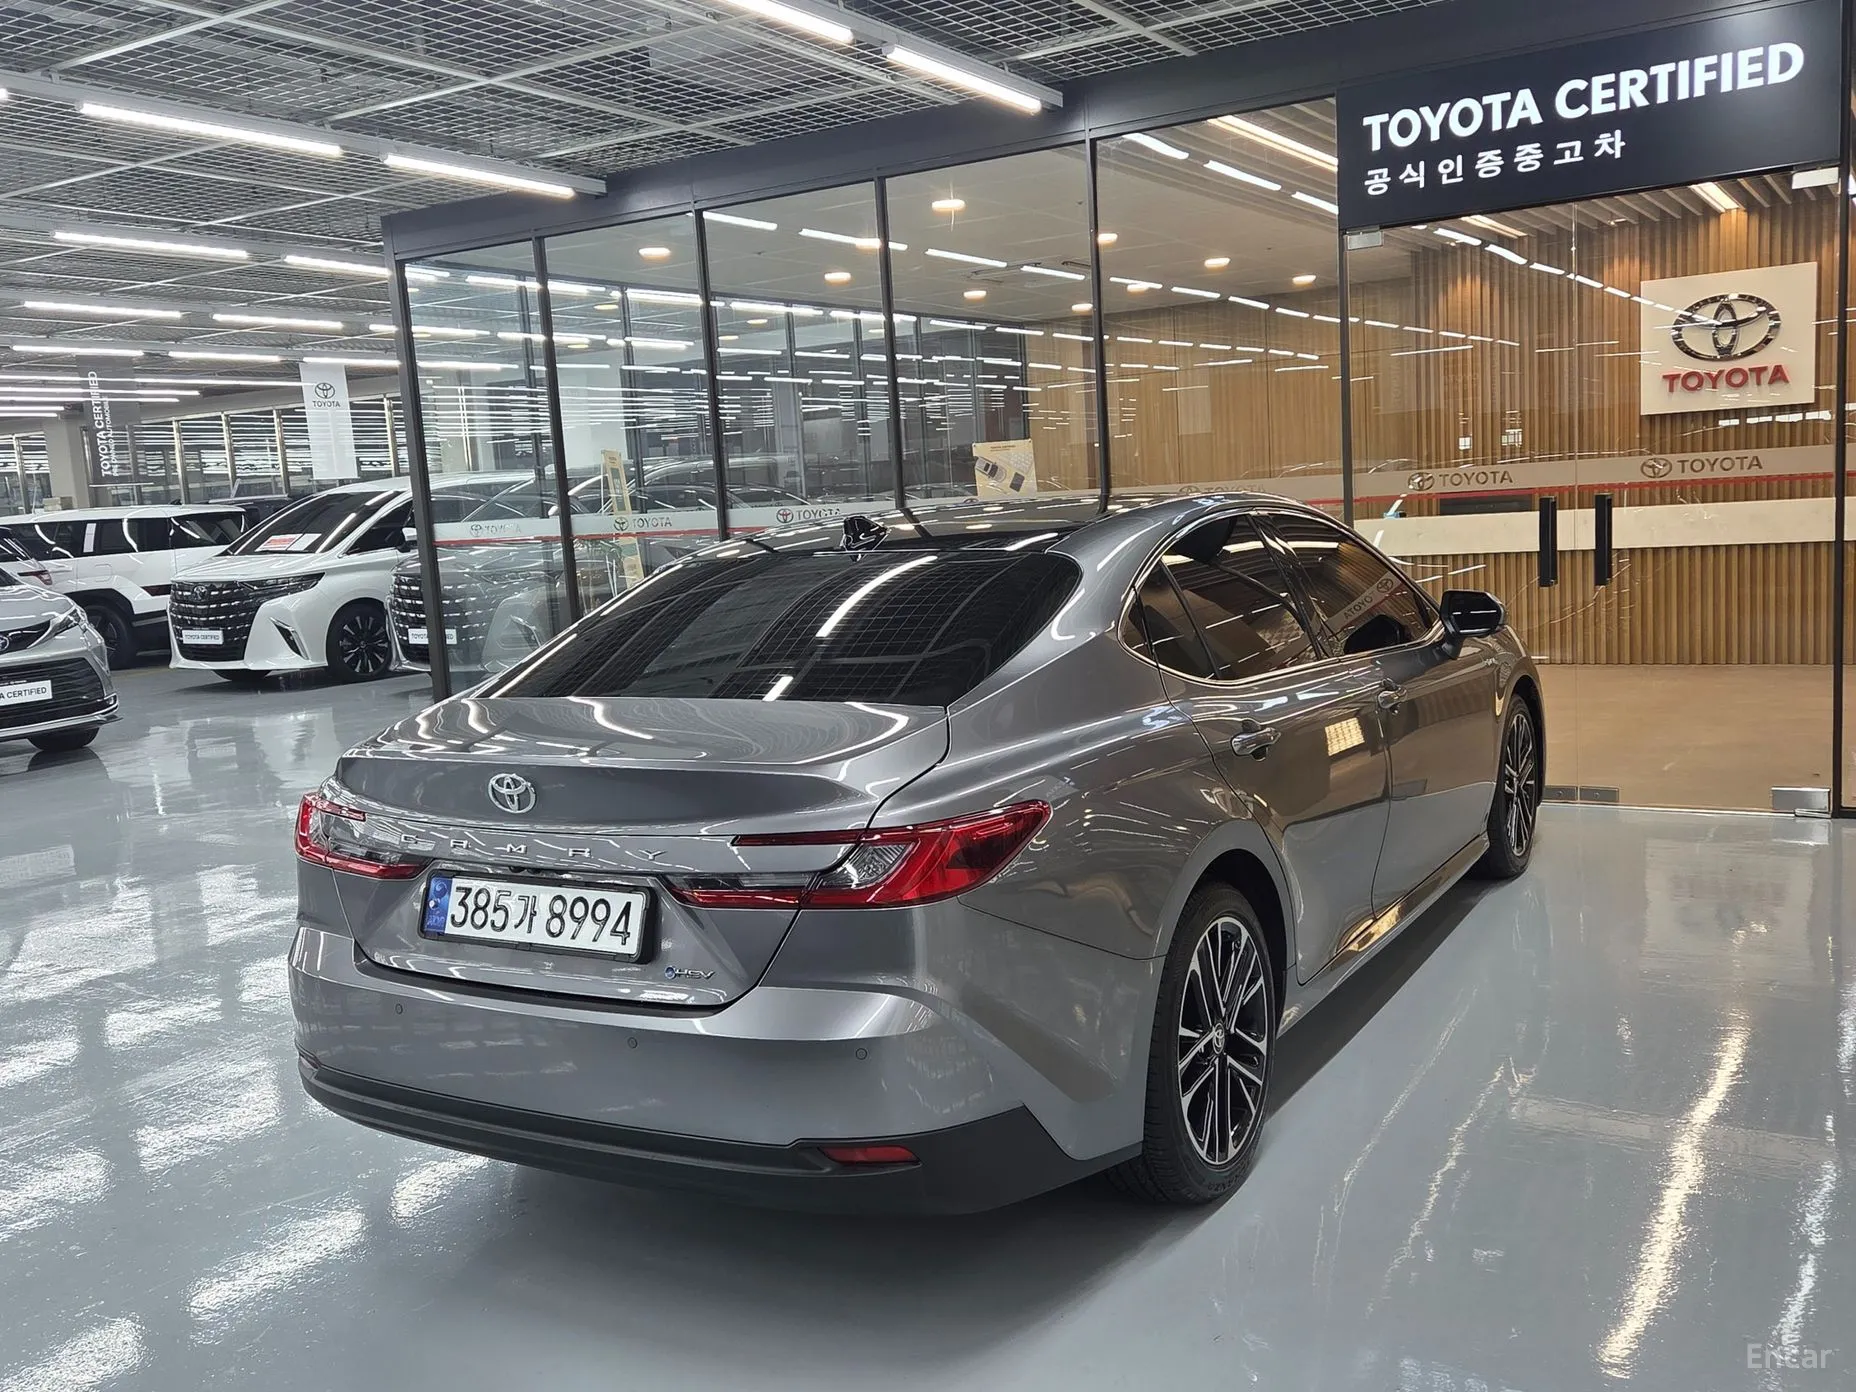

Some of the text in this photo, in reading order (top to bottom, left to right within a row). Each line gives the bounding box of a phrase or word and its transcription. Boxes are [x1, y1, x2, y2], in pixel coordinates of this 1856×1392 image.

[1362, 42, 1806, 152] TOYOTA CERTIFIED
[1364, 129, 1627, 196] 공식인증중고차
[1662, 364, 1790, 393] TOYOTA
[312, 400, 341, 408] TOYOTA
[97, 430, 112, 477] TOYOTA
[1676, 455, 1763, 474] TOYOTA
[1438, 470, 1513, 487] TOYOTA
[632, 516, 673, 529] TOYOTA
[6, 687, 47, 699] CERTIFIED
[401, 834, 667, 861] CAMRY
[450, 886, 632, 946] 385가 8994
[675, 968, 716, 980] HEV
